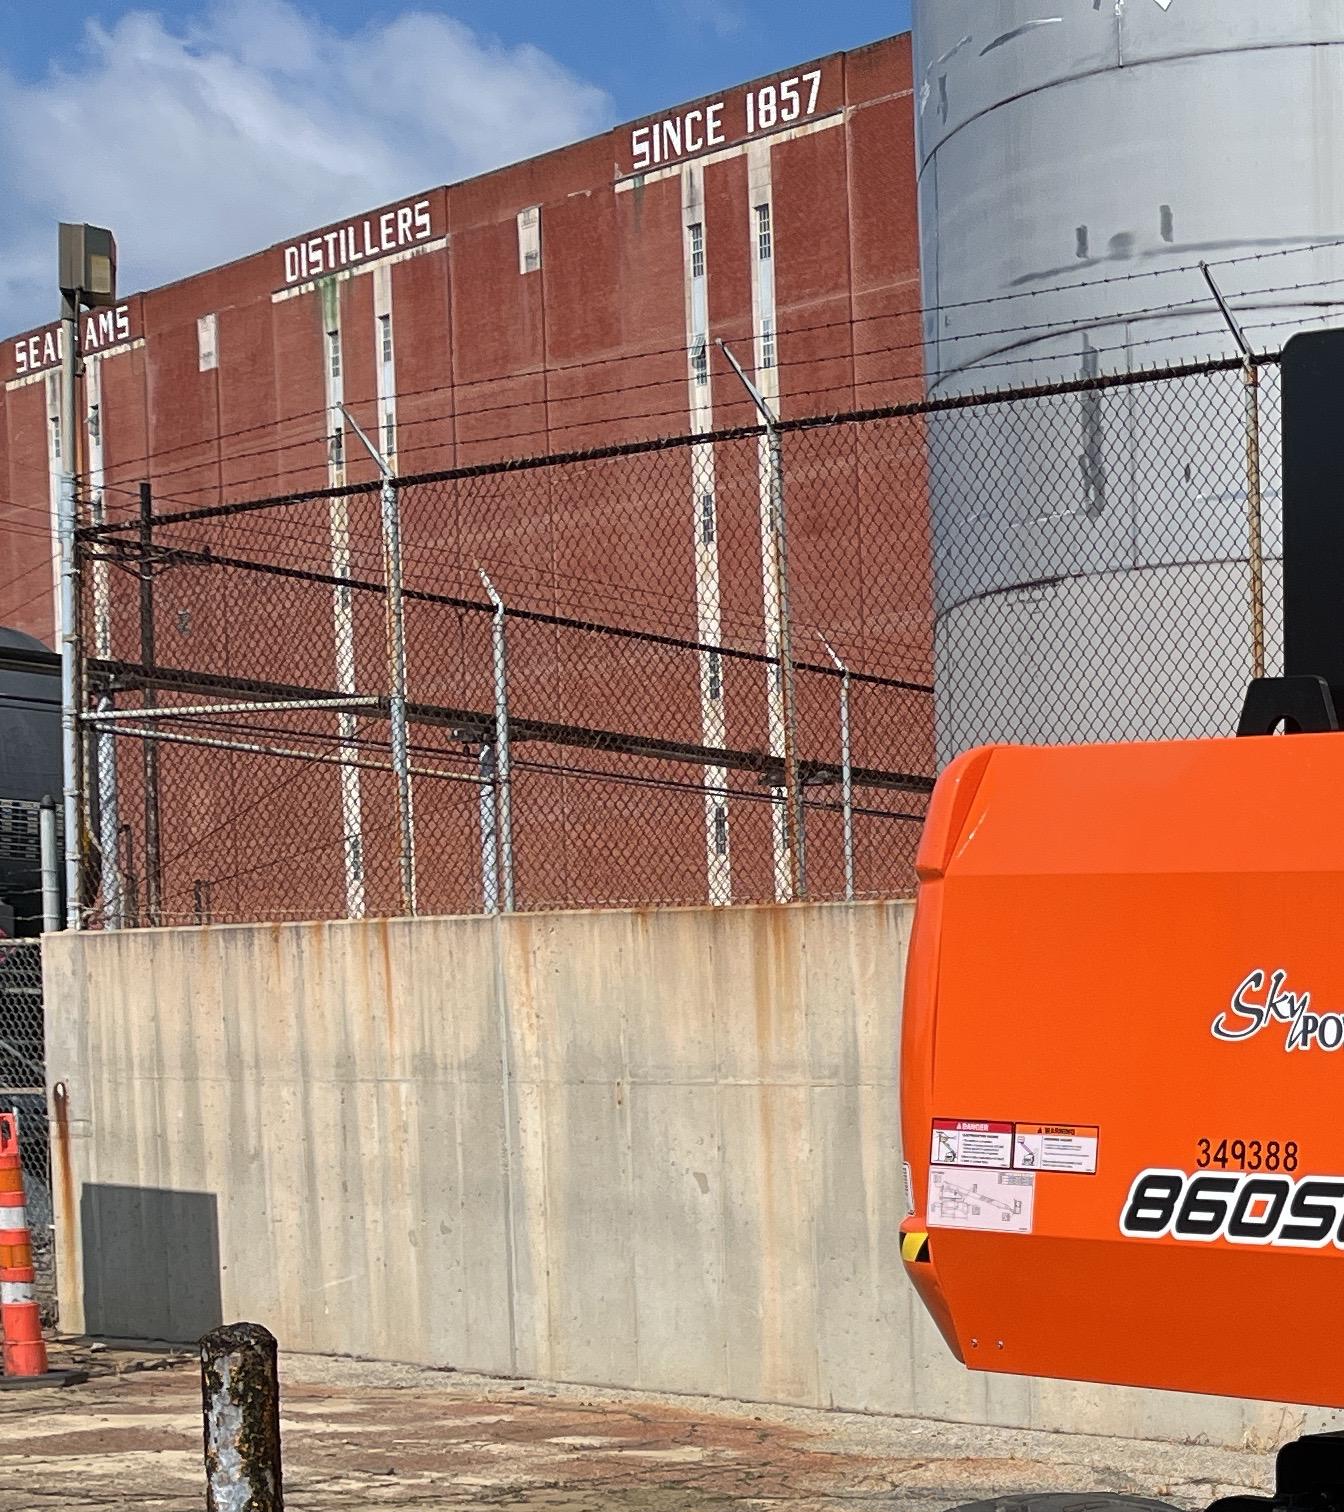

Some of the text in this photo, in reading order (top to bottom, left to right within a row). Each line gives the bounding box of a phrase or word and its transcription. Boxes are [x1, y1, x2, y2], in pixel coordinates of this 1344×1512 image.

[631, 69, 822, 170] SINCE 1857
[284, 199, 432, 283] DISTILLERS
[14, 304, 130, 374] SEAAMS
[1196, 1138, 1299, 1172] 349388
